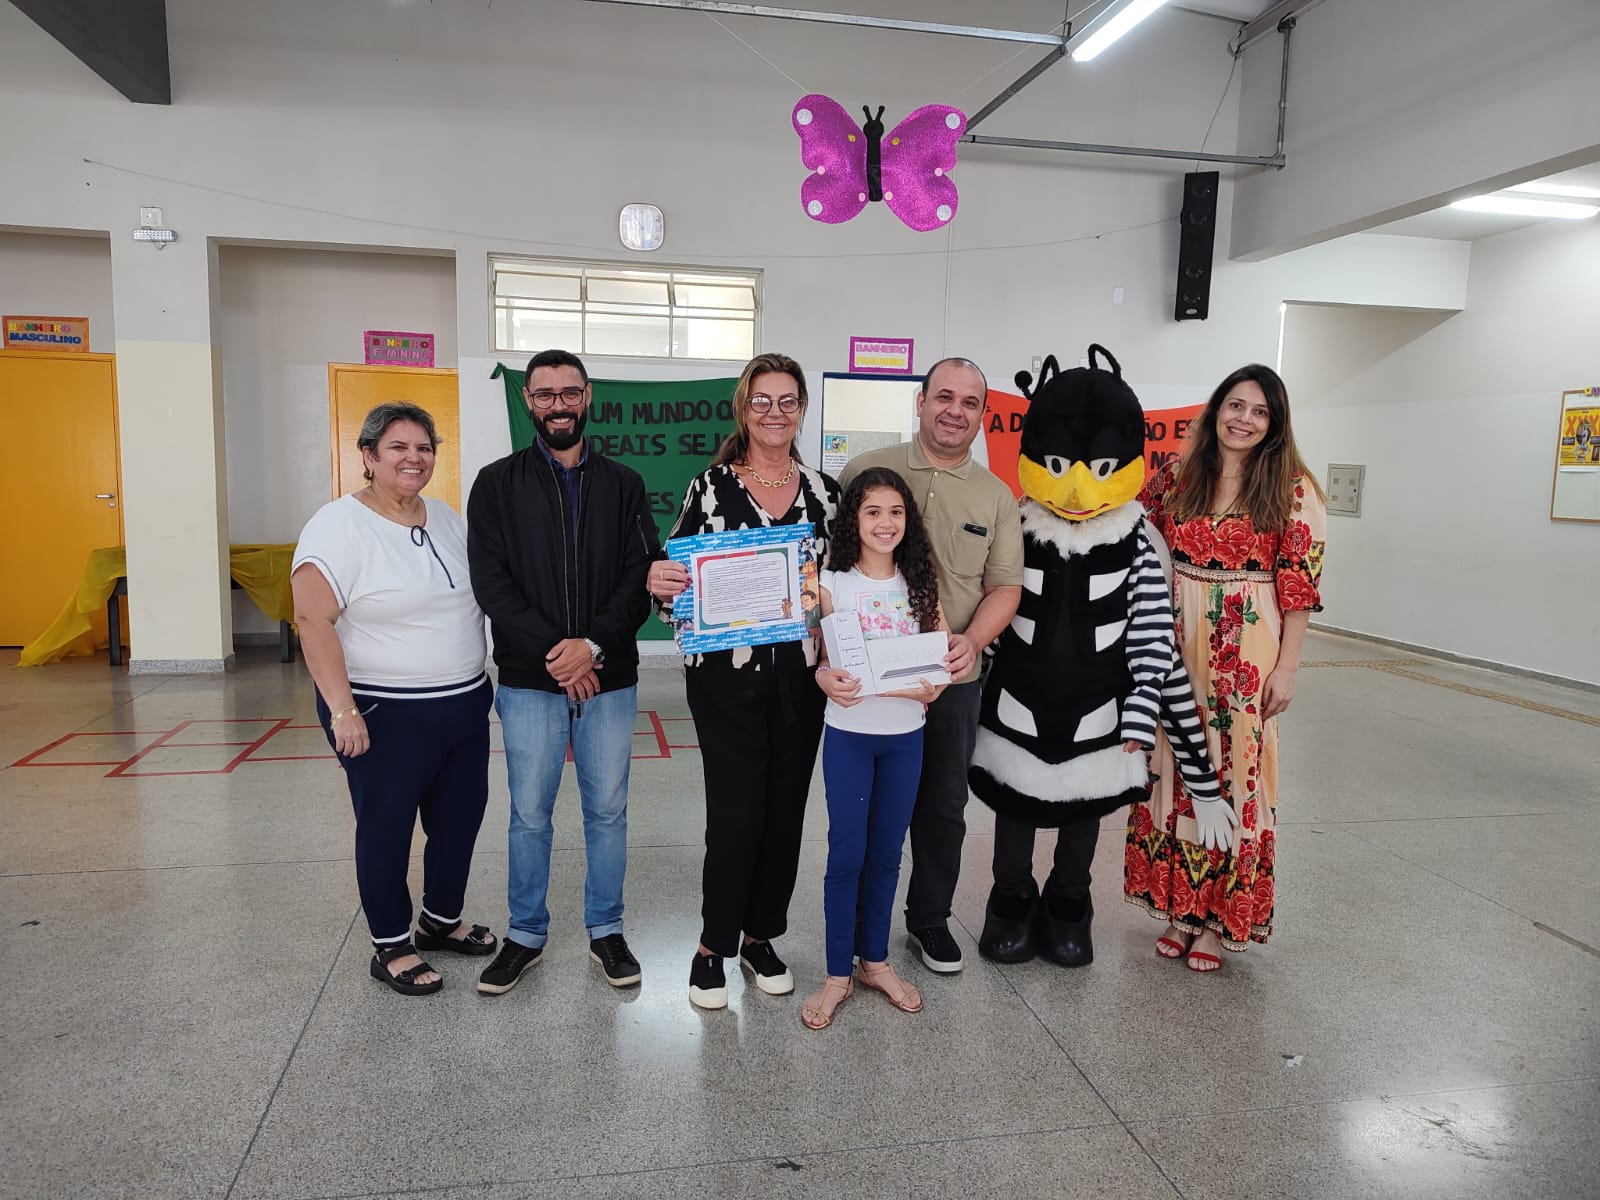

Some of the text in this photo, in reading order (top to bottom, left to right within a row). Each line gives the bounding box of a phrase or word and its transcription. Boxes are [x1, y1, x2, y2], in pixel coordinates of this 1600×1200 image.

[9, 322, 71, 333] BANHEIRO
[10, 333, 81, 344] MASCULINO
[372, 338, 429, 349] BANHEIRO
[373, 347, 428, 359] FEMININO
[589, 401, 623, 424] UM
[632, 400, 712, 424] MUNDO
[587, 433, 727, 456] DEAIS SEJ
[647, 491, 675, 515] ES
